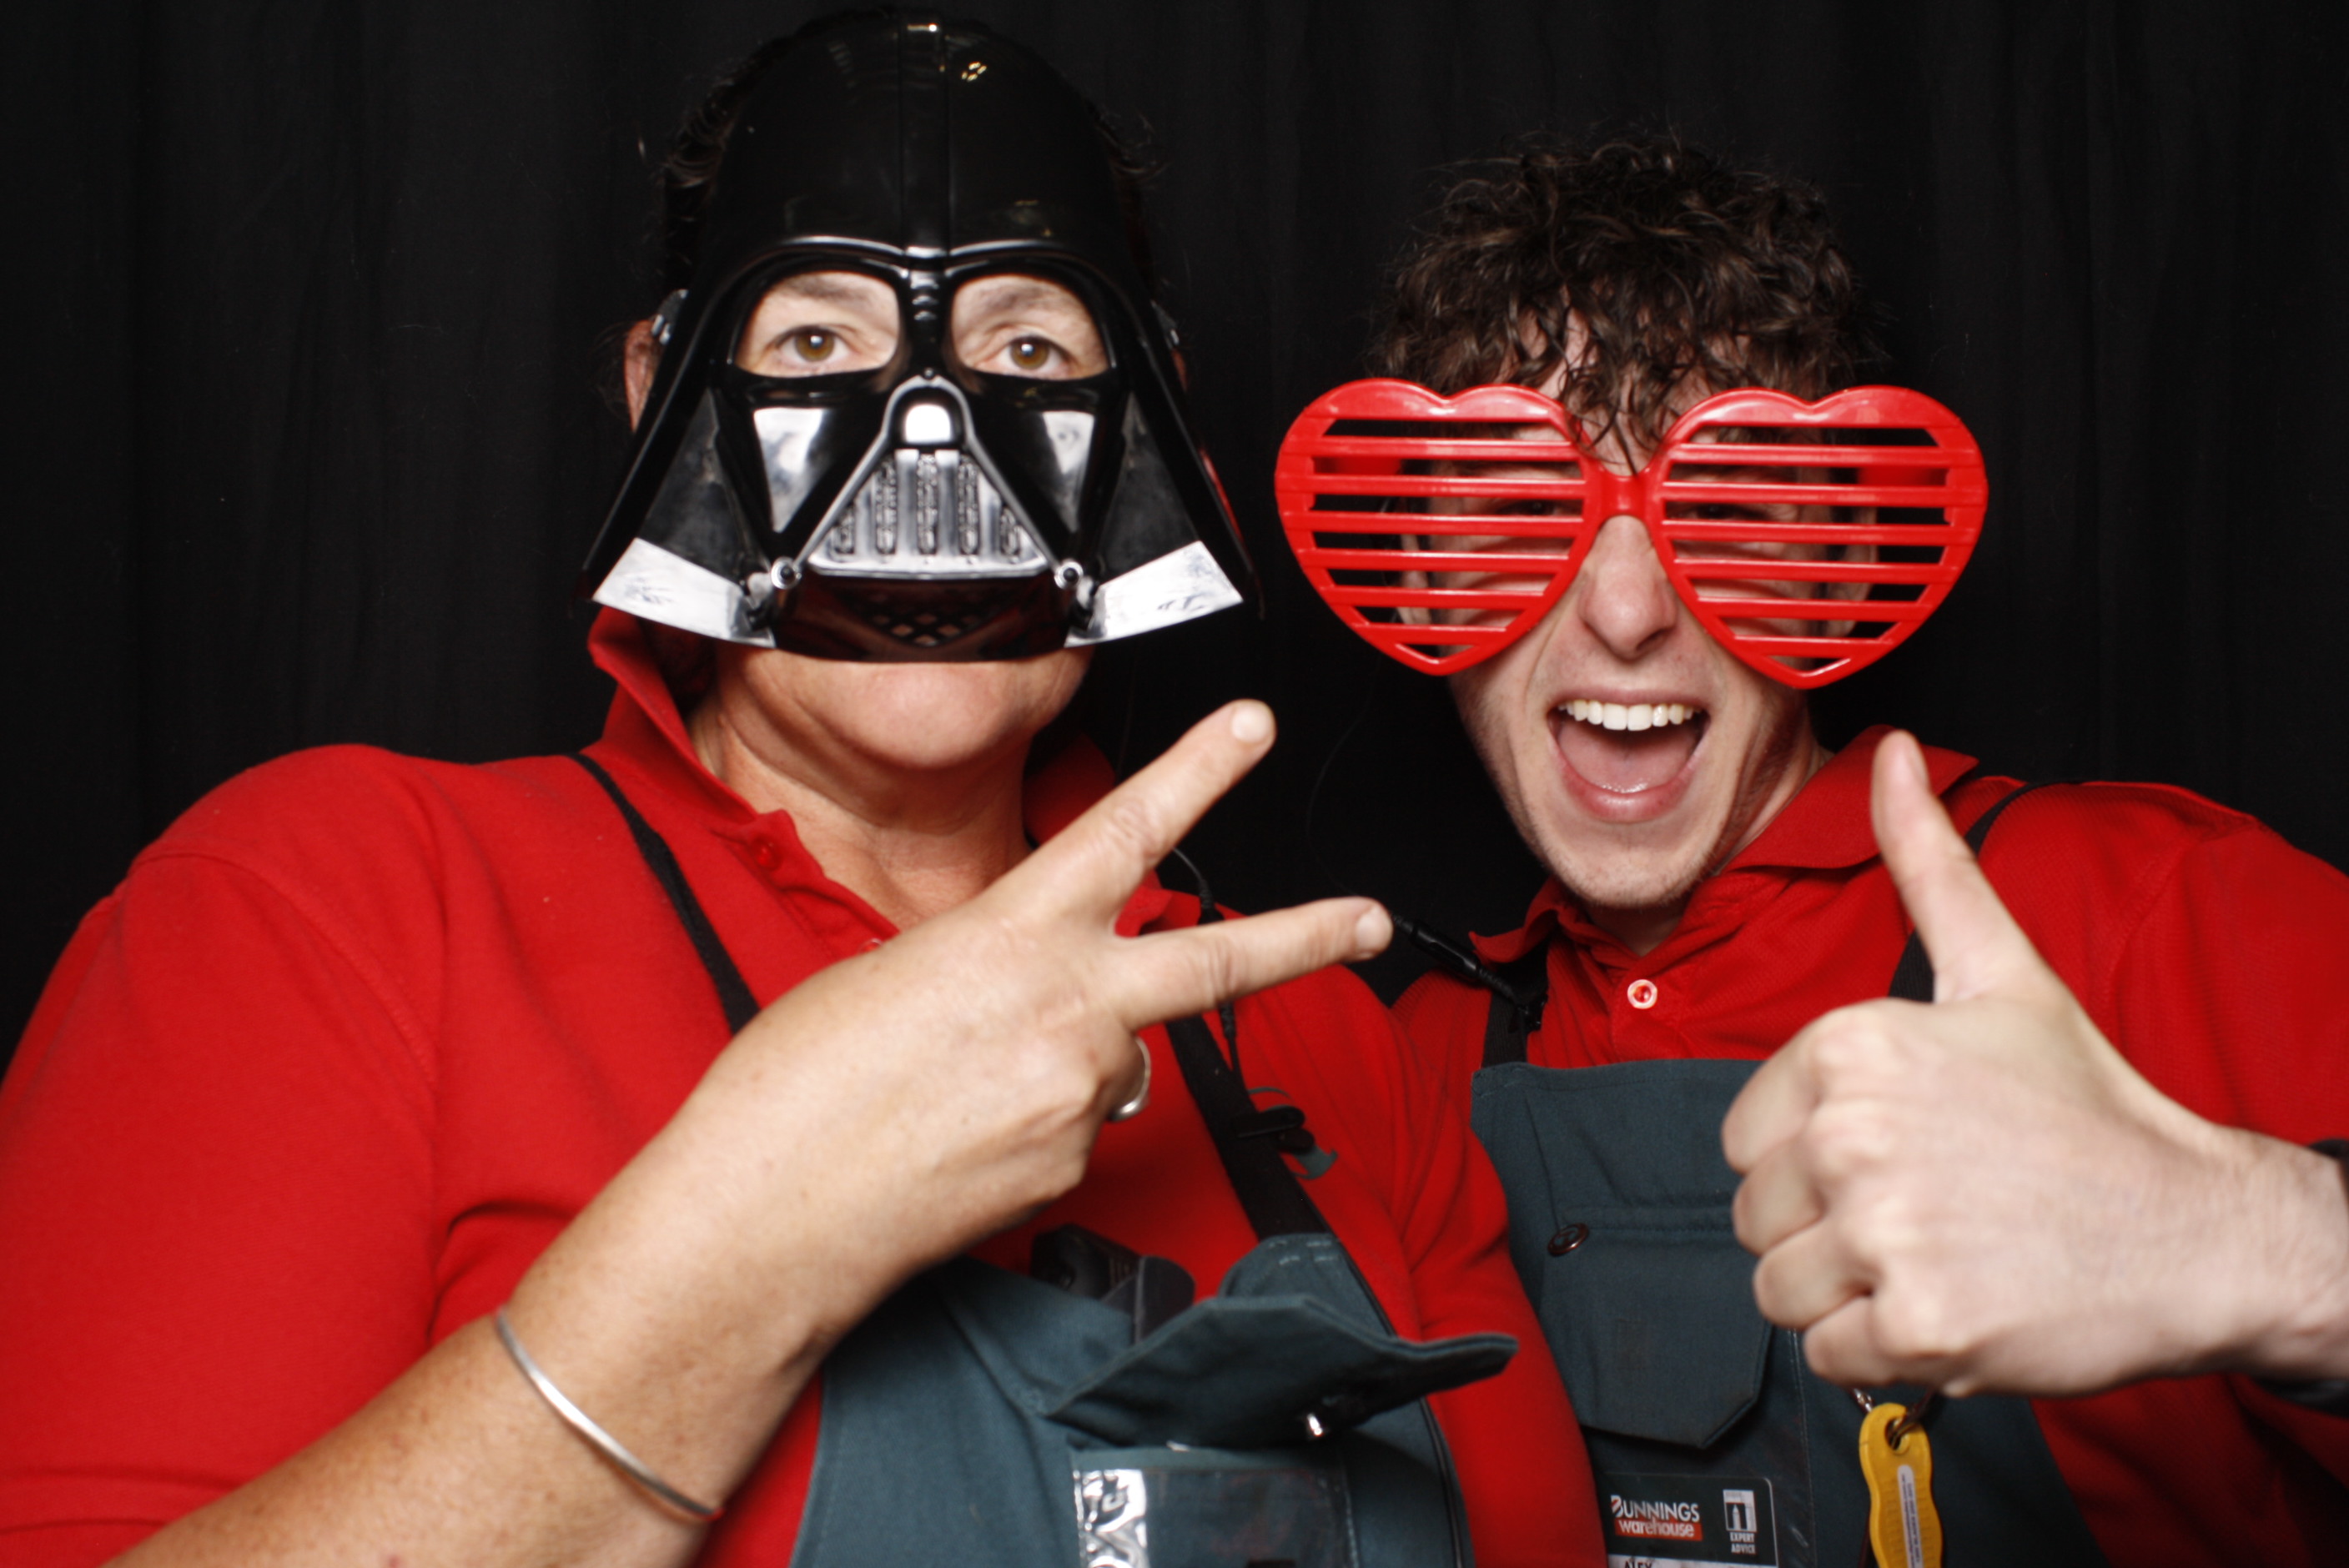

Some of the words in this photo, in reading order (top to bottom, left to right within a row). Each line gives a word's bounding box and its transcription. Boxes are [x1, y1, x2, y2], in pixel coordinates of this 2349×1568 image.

[1611, 1495, 1699, 1522] BUNNINGS
[1618, 1516, 1695, 1538] warehouse
[1730, 1532, 1754, 1542] EXPERT
[1731, 1543, 1755, 1554] ADVICE
